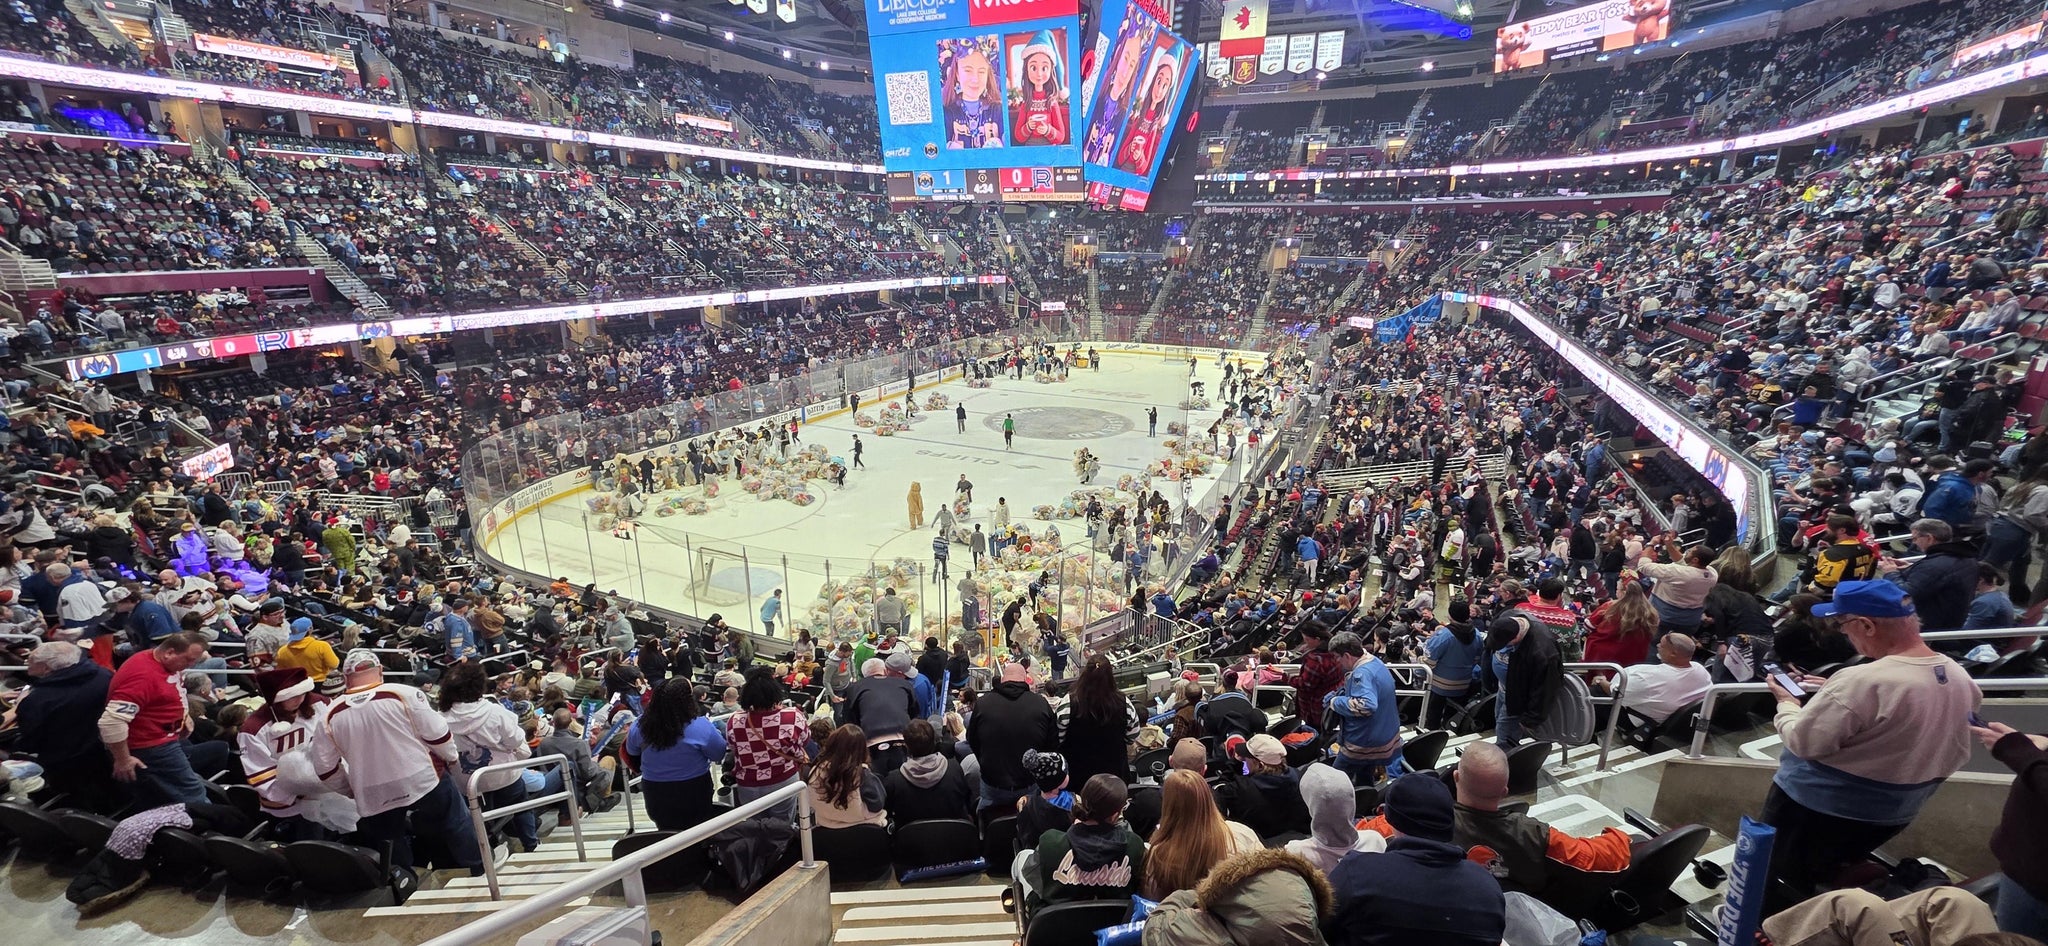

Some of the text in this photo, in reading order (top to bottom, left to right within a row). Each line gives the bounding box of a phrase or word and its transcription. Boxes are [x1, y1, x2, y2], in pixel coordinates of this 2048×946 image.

[1530, 1, 1635, 37] TEDDY BEAR TOSS
[942, 171, 951, 185] 1
[1012, 169, 1022, 185] 0
[973, 184, 994, 194] 4:34
[224, 341, 236, 353] 0
[143, 352, 151, 365] 1
[766, 412, 789, 423] CENTER
[516, 480, 553, 501] COLUMBUS
[518, 487, 554, 509] BLUE JACKETS
